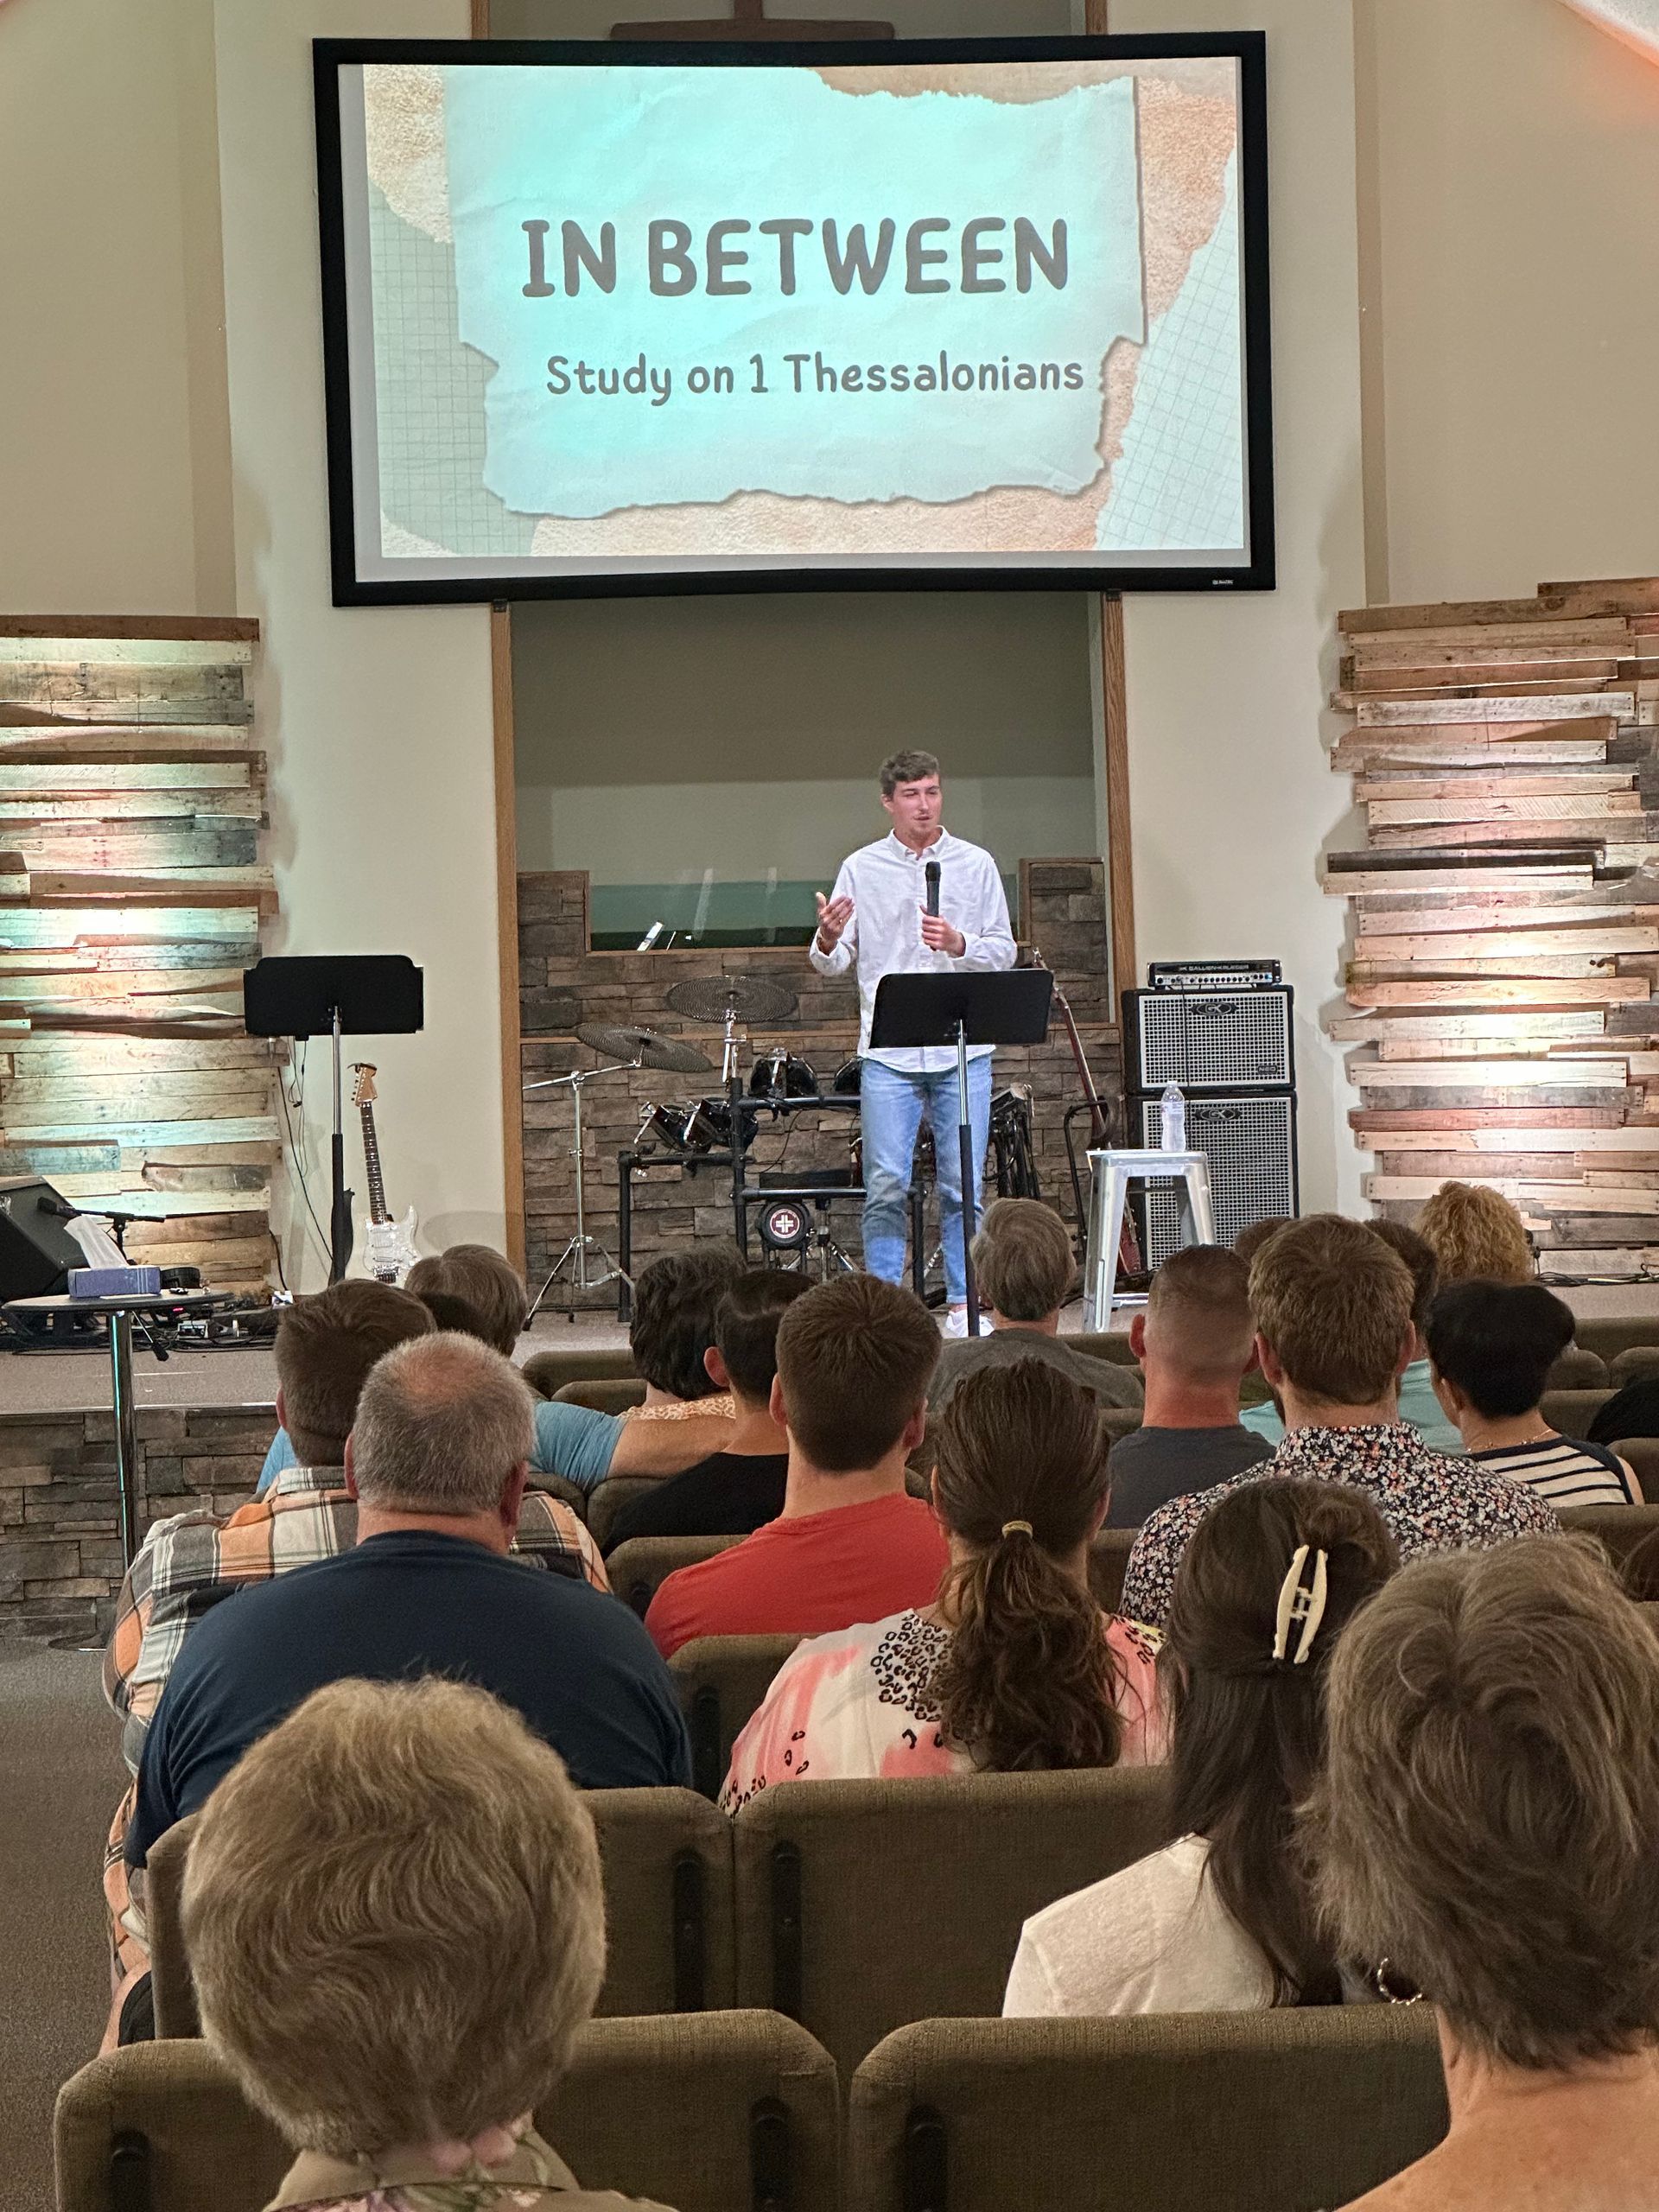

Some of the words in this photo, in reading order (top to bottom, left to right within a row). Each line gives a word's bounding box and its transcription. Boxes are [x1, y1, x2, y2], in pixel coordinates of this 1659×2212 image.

[521, 219, 617, 298] IN
[648, 217, 1068, 297] BETWEEN
[546, 353, 671, 407] Study
[687, 366, 734, 393] on
[749, 354, 769, 393] 1
[783, 350, 1084, 393] Thessalonians
[1205, 1003, 1223, 1014] GK
